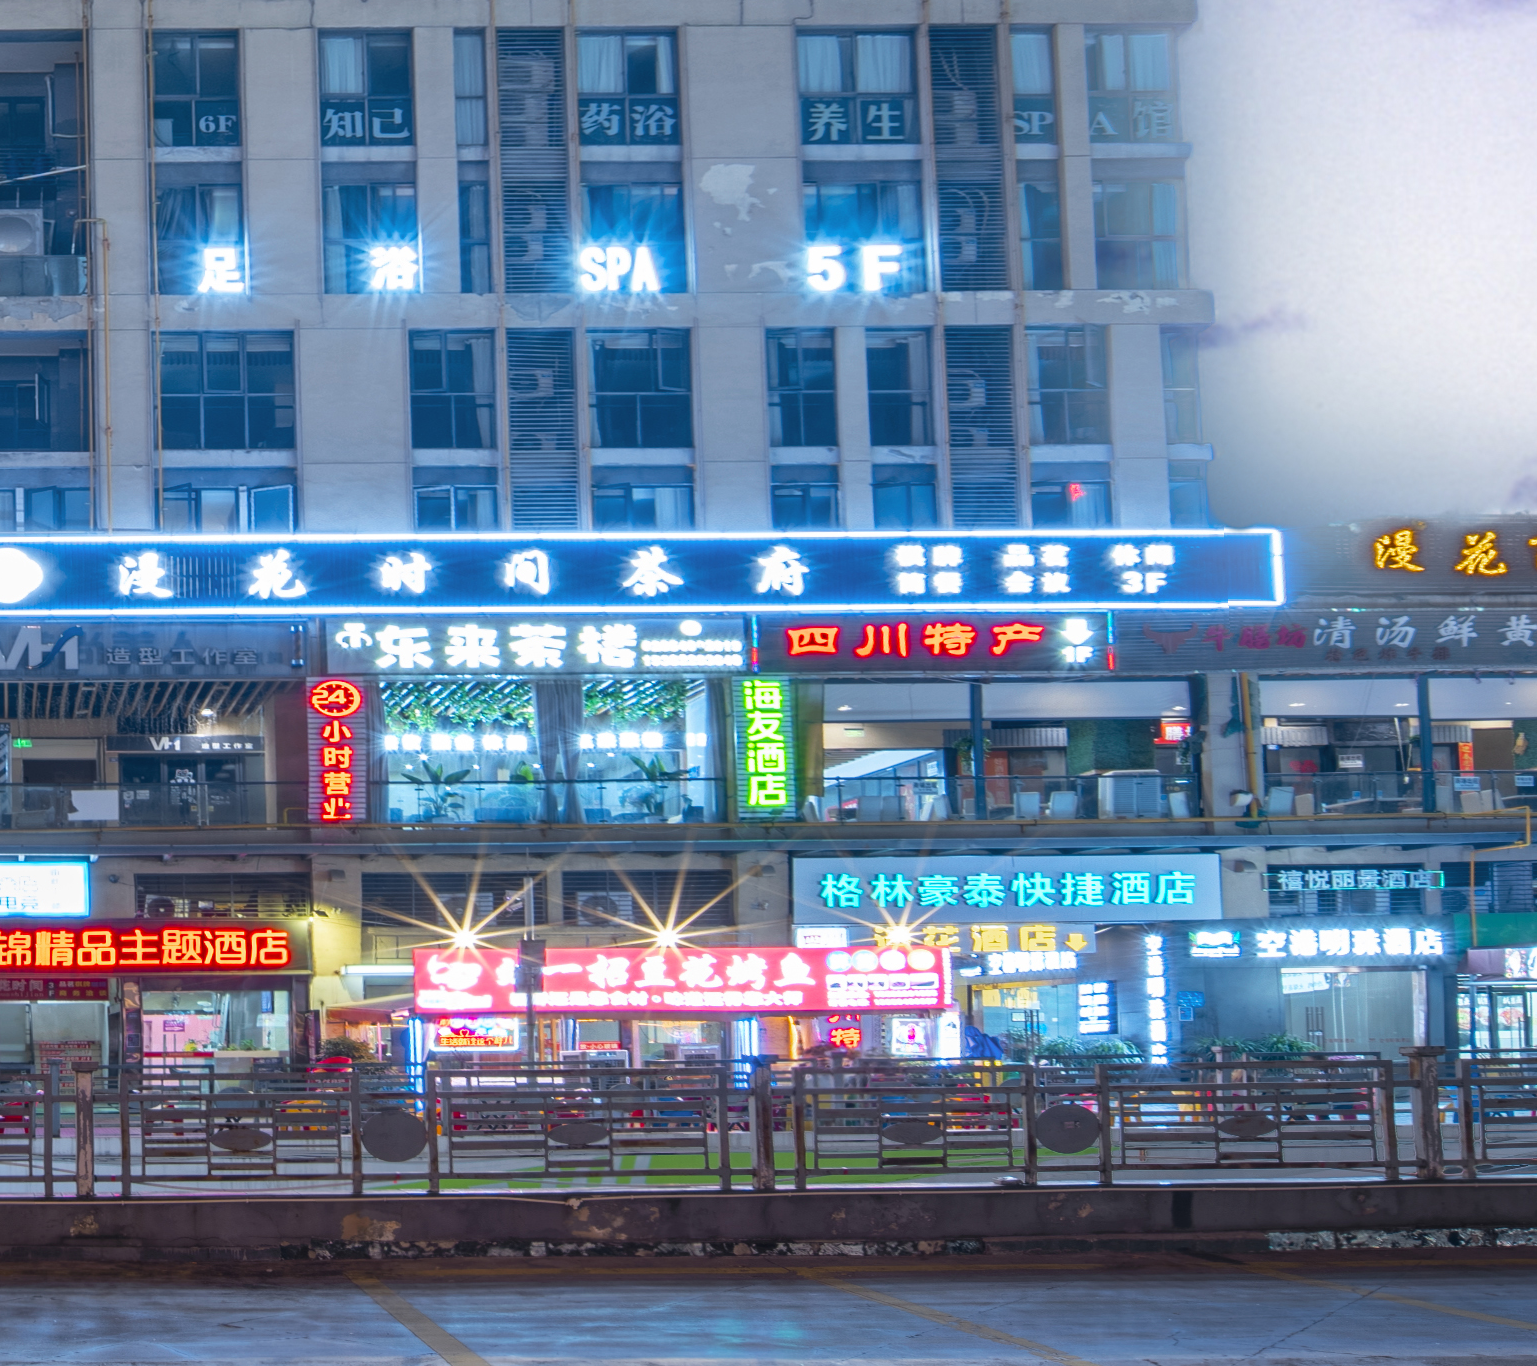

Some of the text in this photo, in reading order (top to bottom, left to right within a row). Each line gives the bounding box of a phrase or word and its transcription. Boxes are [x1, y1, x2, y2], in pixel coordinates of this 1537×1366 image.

[199, 101, 1173, 141] 6F 知己 药浴 养生 SPA 馆
[198, 244, 902, 293] 足浴 SPA 5F
[1003, 544, 1071, 567] 品茗
[119, 547, 810, 598] 漫花时间茶府
[1004, 571, 1072, 594] 会议
[1121, 571, 1168, 594] 3F
[375, 624, 637, 669] 东来茶楼
[787, 623, 1045, 657] 四川特产
[1202, 624, 1309, 652] 牛膳坊
[105, 646, 259, 666] 造型工作室
[201, 742, 254, 750] 造型工作室
[743, 680, 787, 806] 海友酒店
[820, 872, 1196, 908] 格林豪泰快捷酒店
[1277, 869, 1433, 890] 禧悦丽景酒店
[1256, 928, 1445, 957] 空港明珠酒店
